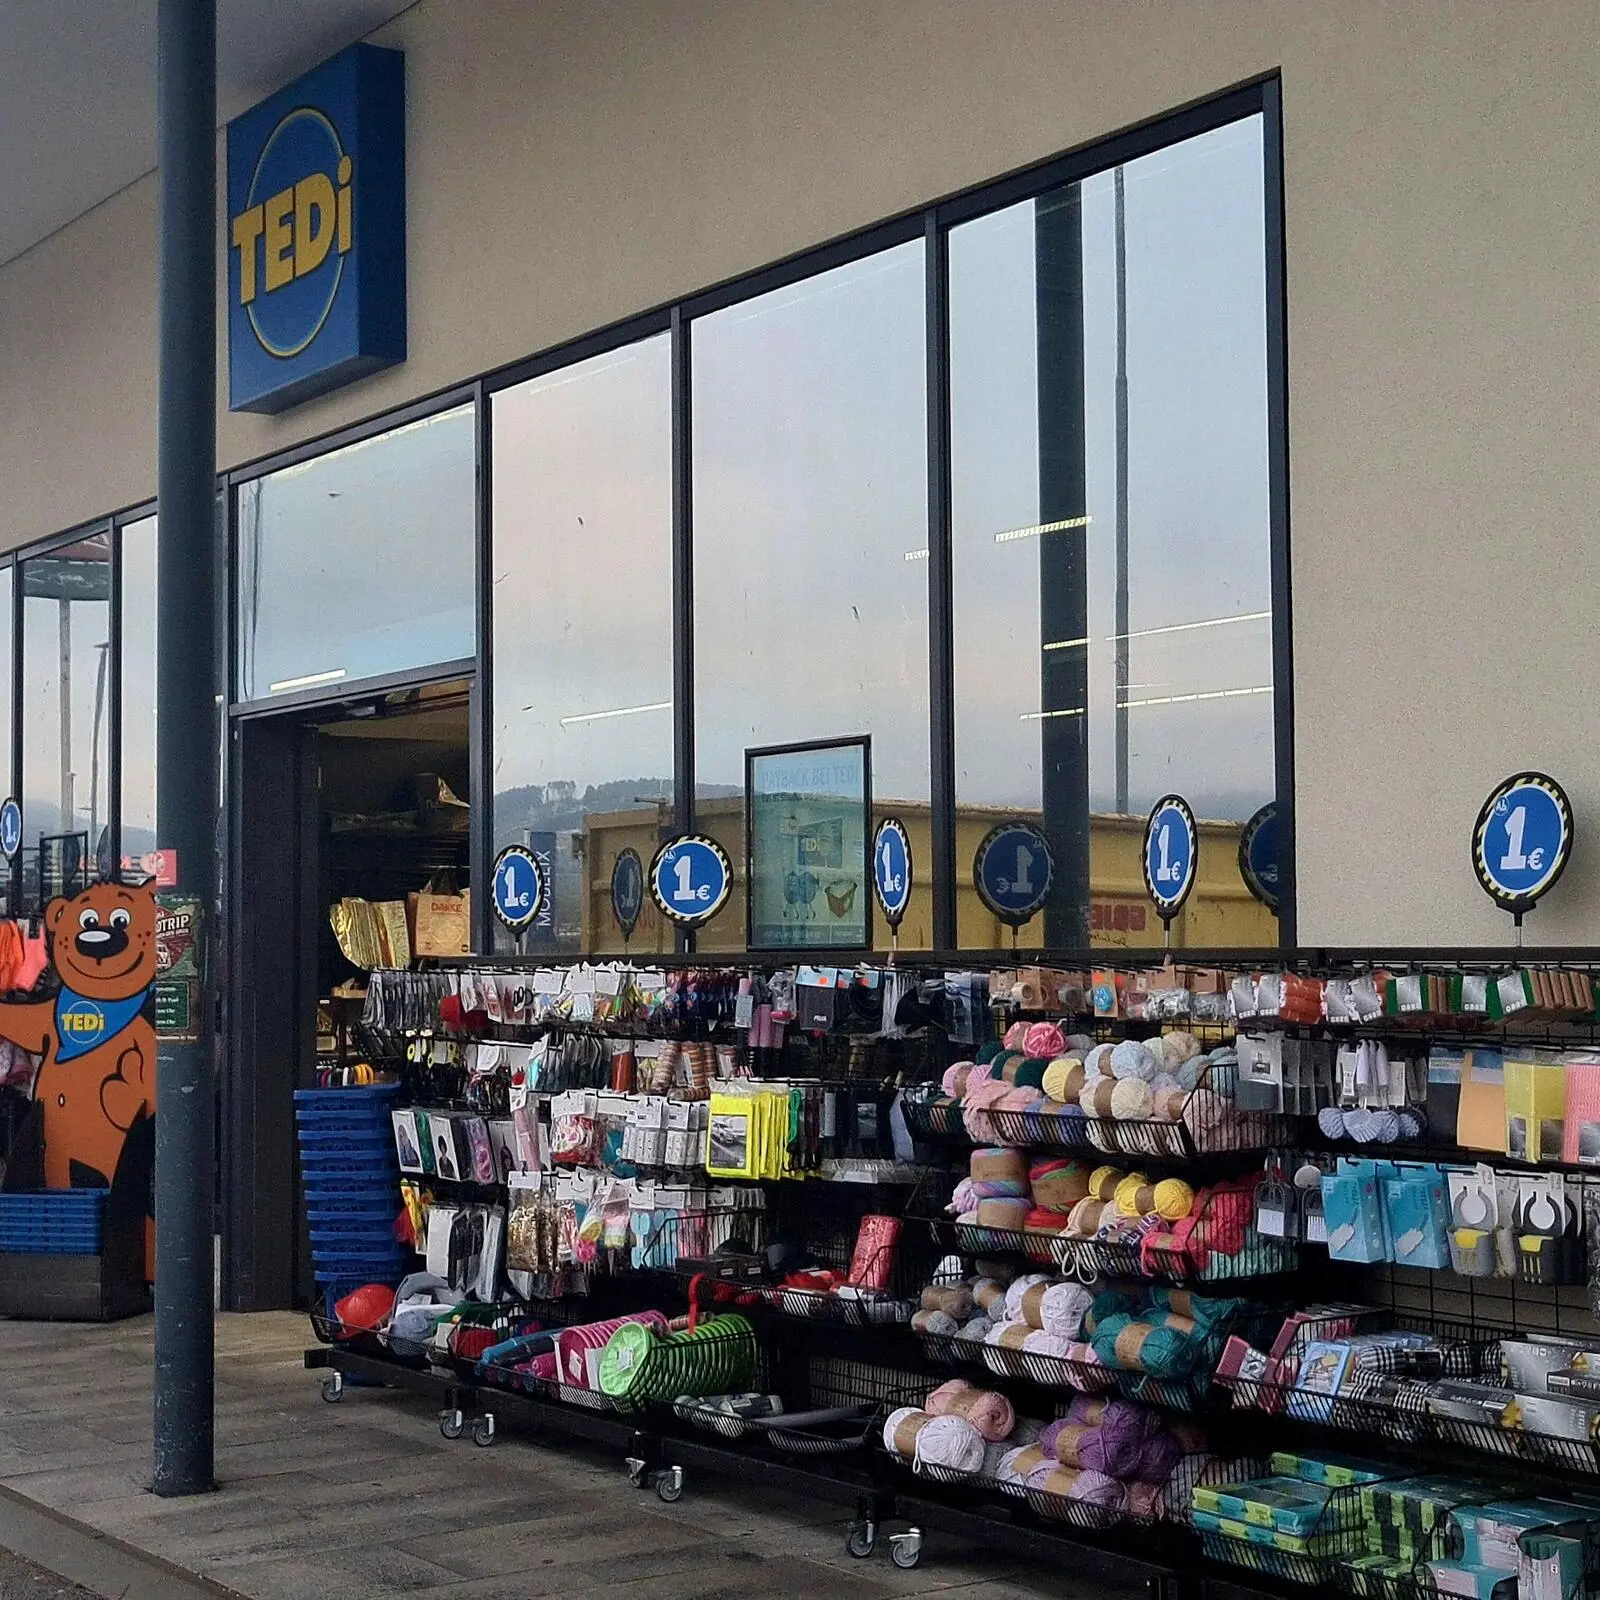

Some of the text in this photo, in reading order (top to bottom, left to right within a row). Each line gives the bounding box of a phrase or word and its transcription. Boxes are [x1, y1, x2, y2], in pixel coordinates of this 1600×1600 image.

[233, 155, 352, 304] TEDi
[761, 767, 811, 788] PAYBACK
[812, 766, 831, 785] BEI
[61, 1013, 105, 1031] TEDi
